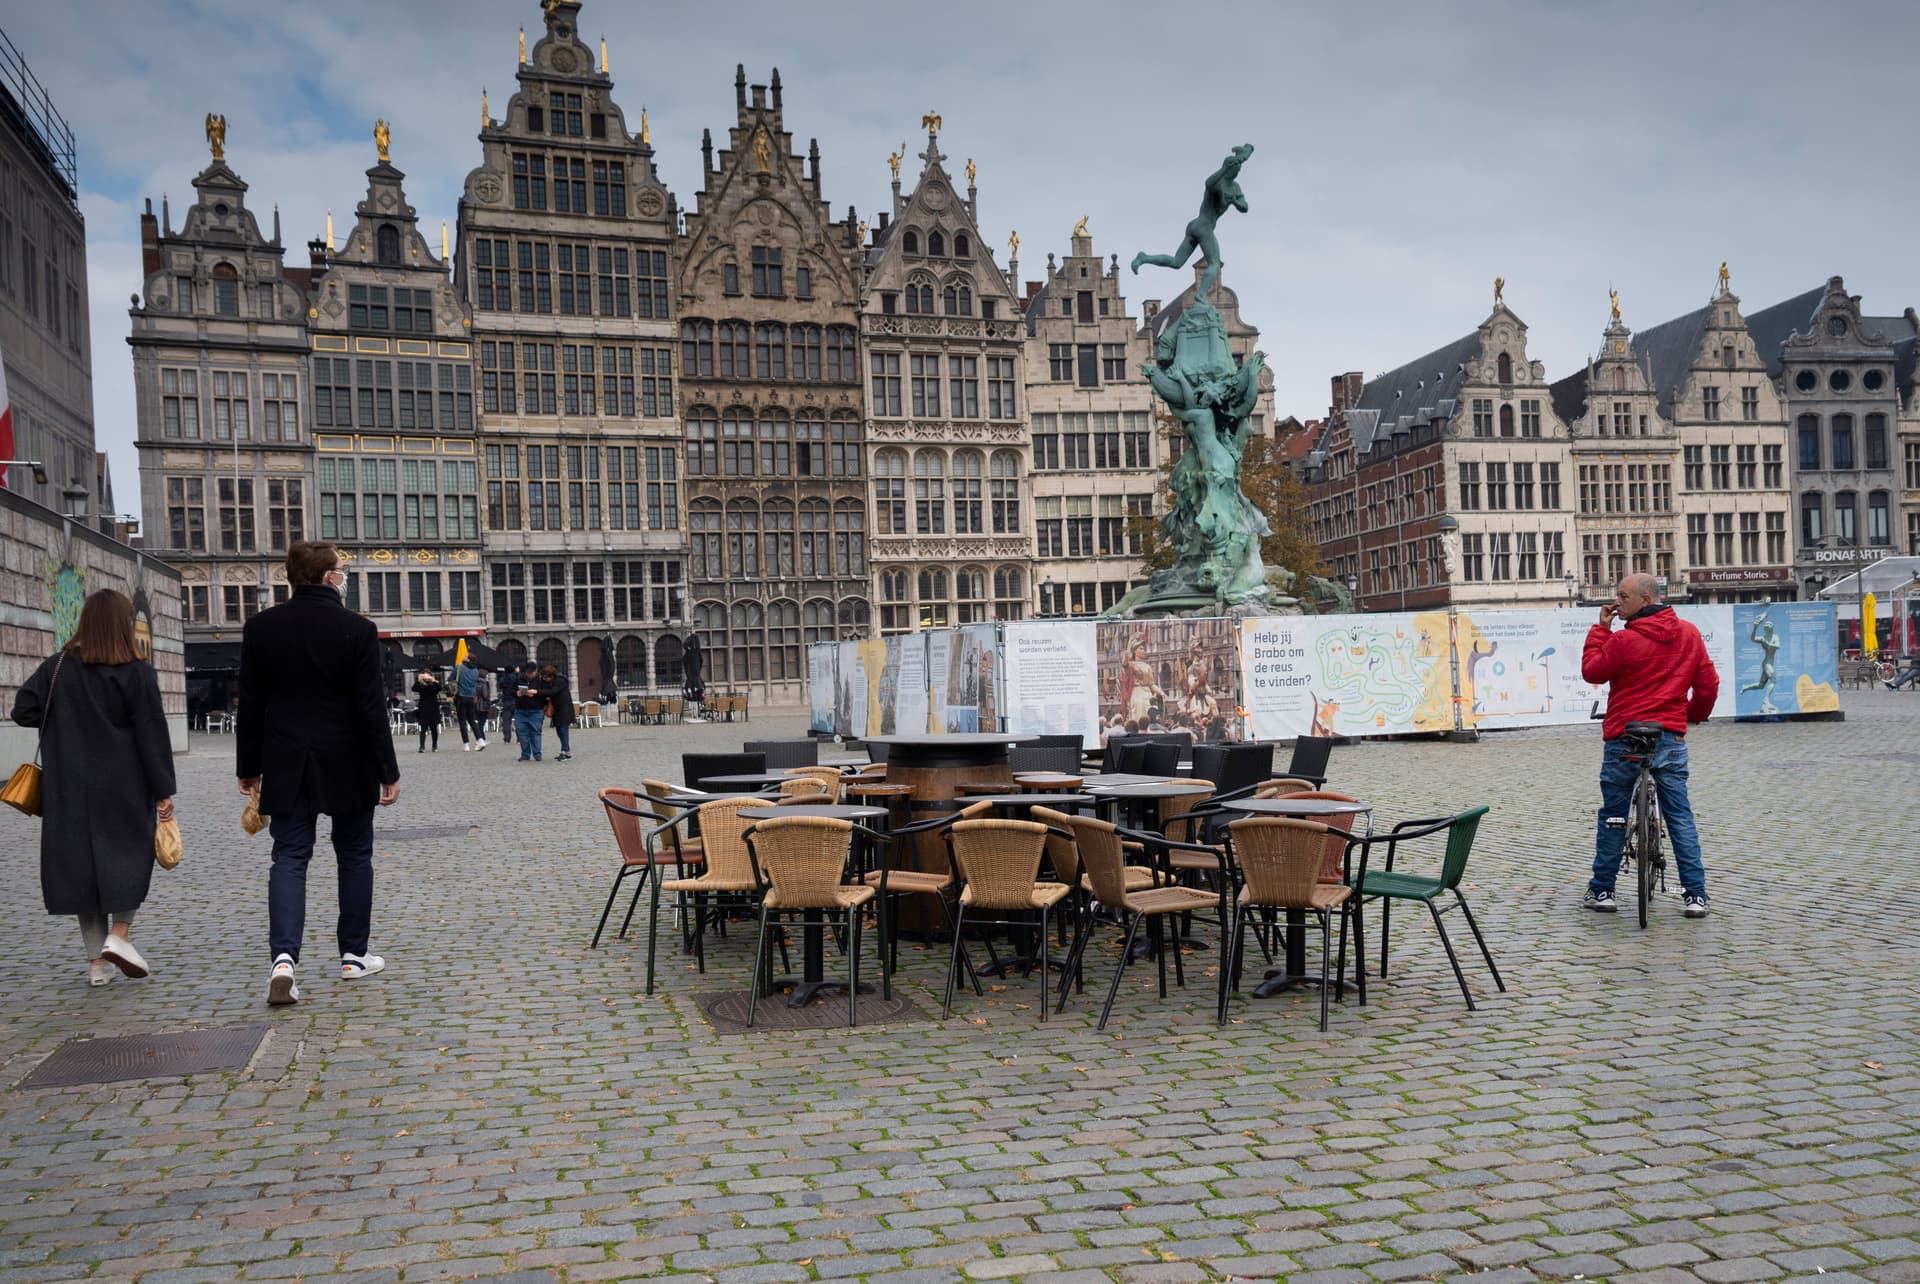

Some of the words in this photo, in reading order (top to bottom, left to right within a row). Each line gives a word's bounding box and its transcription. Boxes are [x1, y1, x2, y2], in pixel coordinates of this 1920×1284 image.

[1711, 571, 1742, 580] Perfume
[1743, 570, 1769, 580] Stories
[1254, 632, 1279, 645] Help
[1280, 631, 1292, 645] jij
[1254, 647, 1286, 659] Brabo
[1288, 648, 1304, 657] om
[1254, 662, 1268, 673] de
[1270, 663, 1293, 673] reus
[1254, 677, 1266, 688] te
[1268, 674, 1312, 688] vinden?
